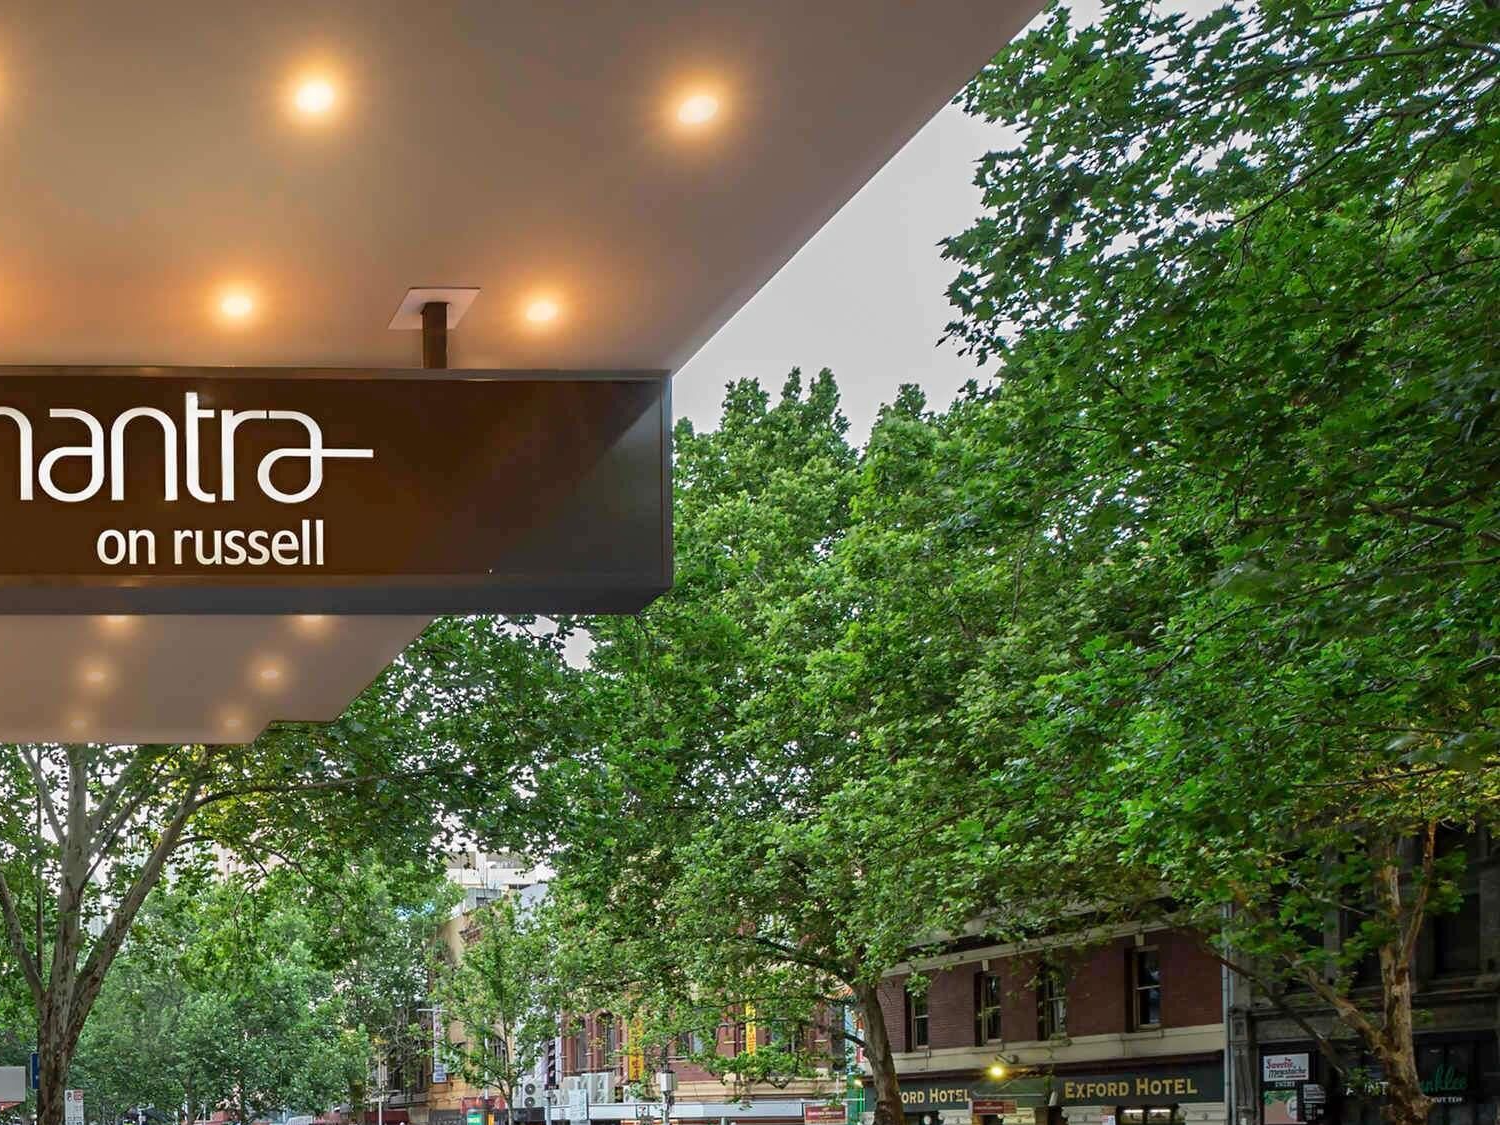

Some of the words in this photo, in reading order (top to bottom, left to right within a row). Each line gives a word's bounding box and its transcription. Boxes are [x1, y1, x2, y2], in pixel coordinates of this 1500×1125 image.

[96, 523, 158, 567] on
[173, 517, 325, 567] russell
[897, 1090, 925, 1104] ORD
[929, 1087, 972, 1102] HOTEL
[1064, 1081, 1130, 1099] EXFORD
[1135, 1077, 1198, 1096] HOTEL
